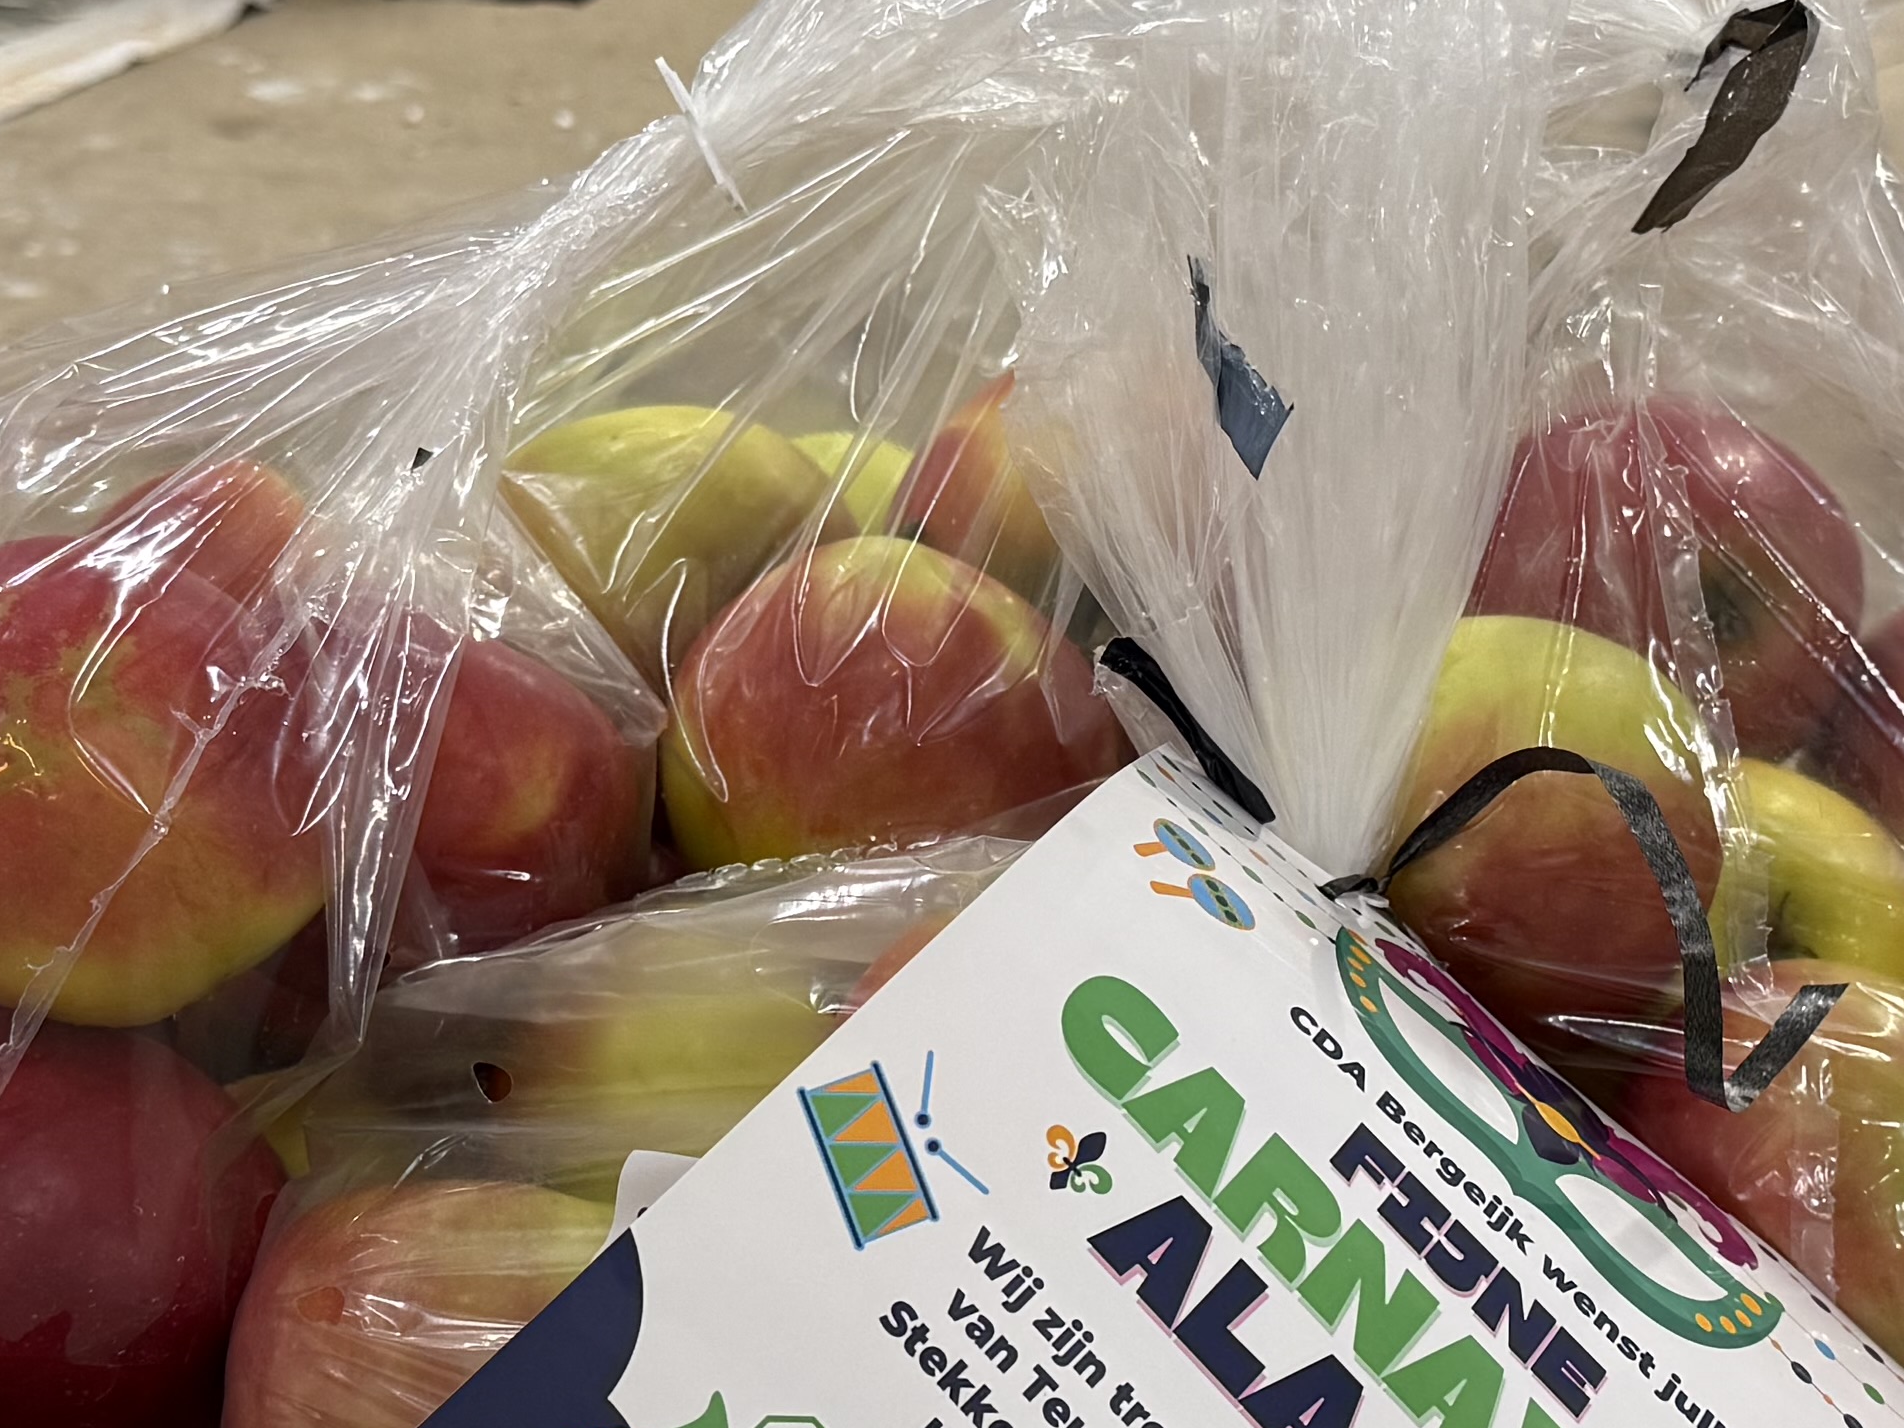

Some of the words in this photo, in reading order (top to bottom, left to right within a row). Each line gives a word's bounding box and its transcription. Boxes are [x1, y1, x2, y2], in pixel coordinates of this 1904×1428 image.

[967, 1224, 1045, 1314] Wij
[1032, 1306, 1107, 1388] zijn
[1290, 1006, 1367, 1093] CDA
[1375, 1090, 1535, 1257] Bergeijk
[1542, 1253, 1657, 1381] wenst
[1329, 1122, 1607, 1422] FIJNE
[946, 1287, 1019, 1374] van
